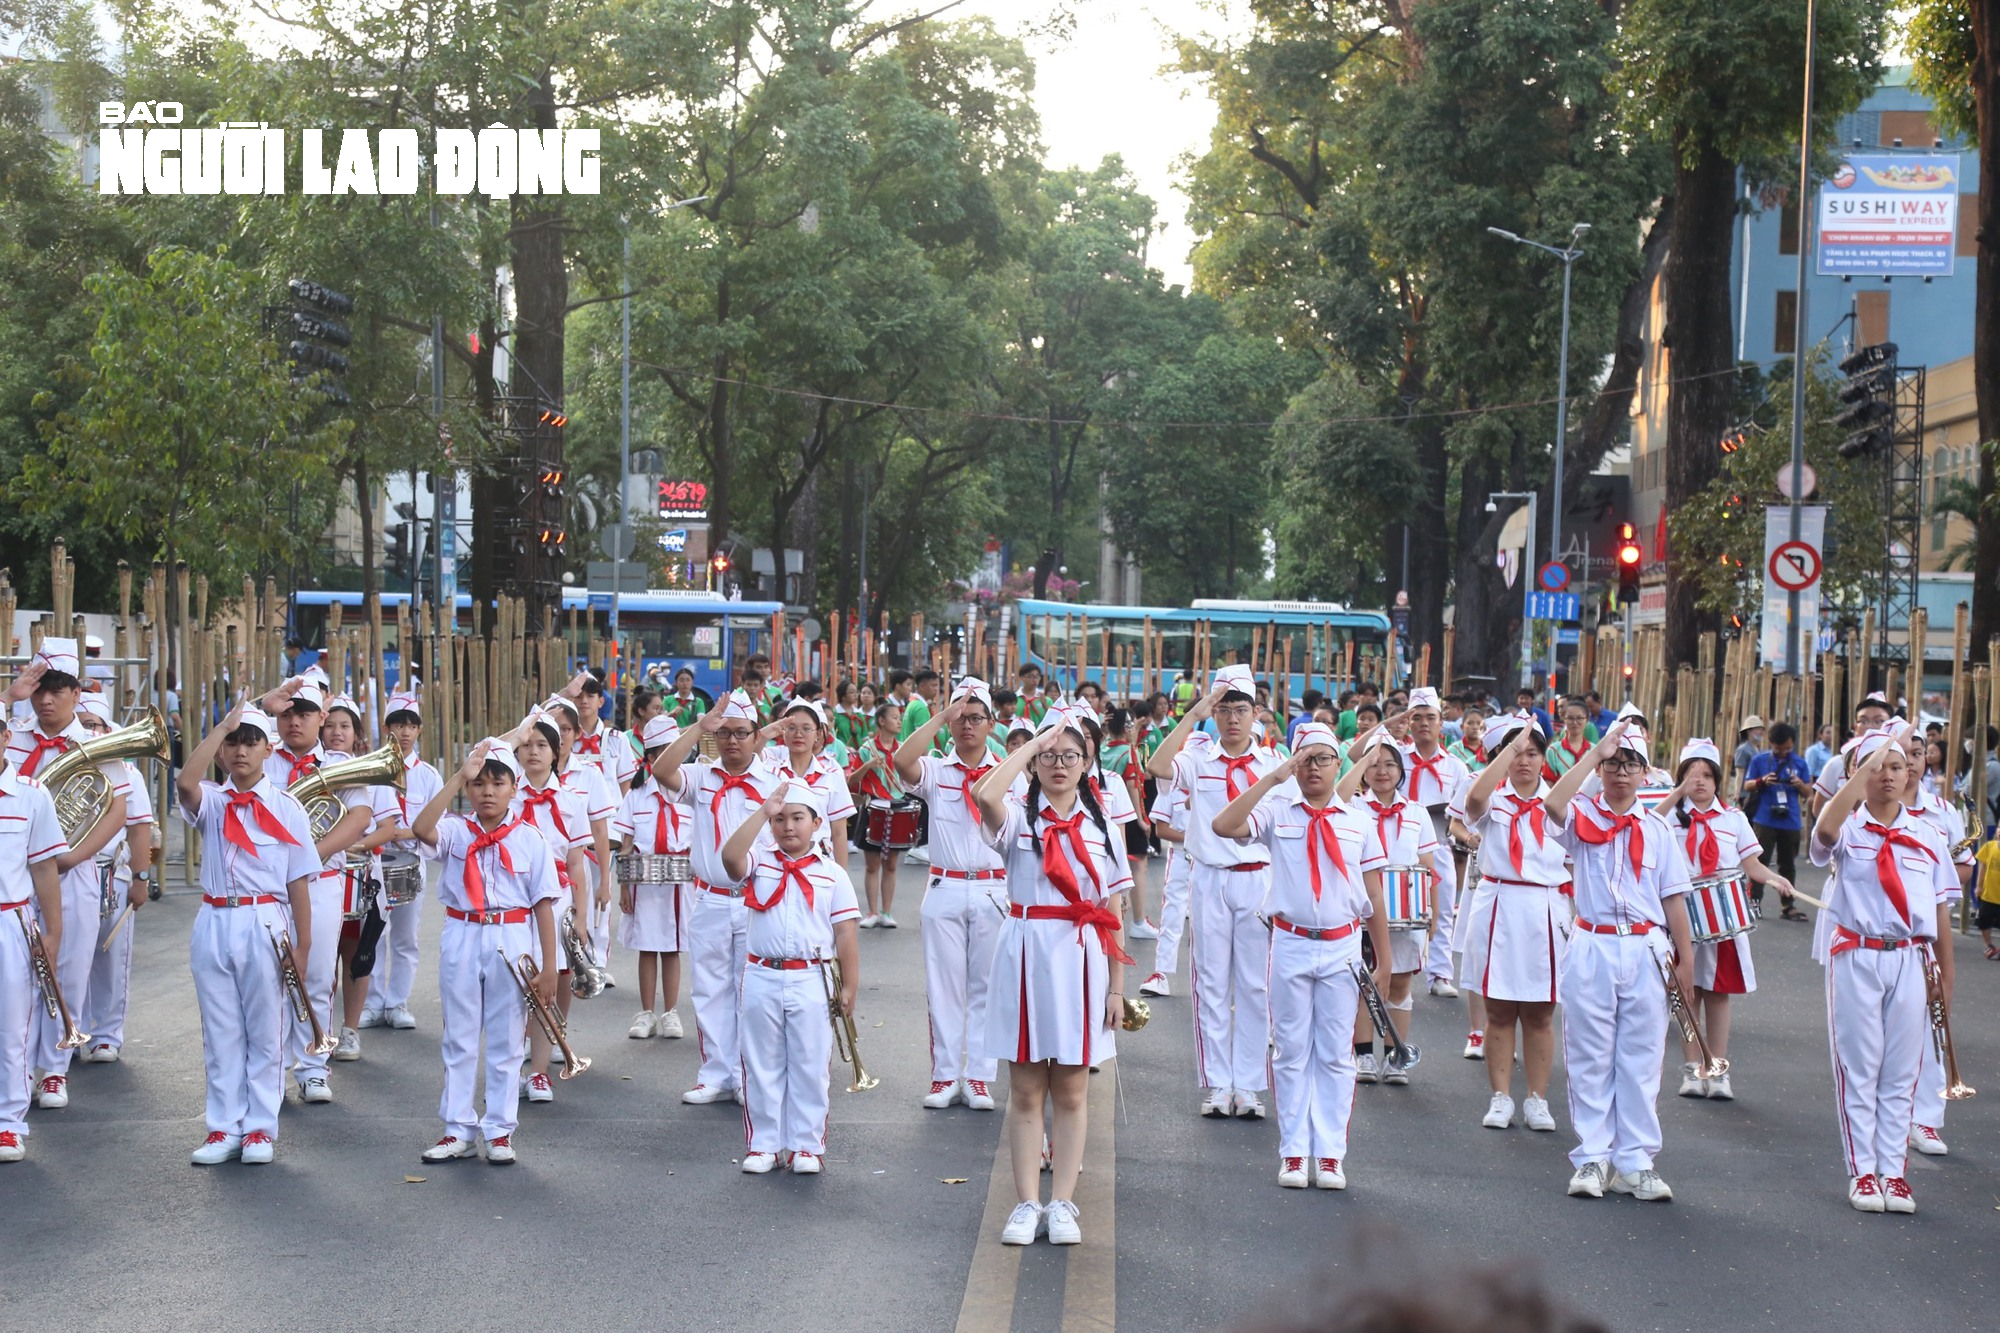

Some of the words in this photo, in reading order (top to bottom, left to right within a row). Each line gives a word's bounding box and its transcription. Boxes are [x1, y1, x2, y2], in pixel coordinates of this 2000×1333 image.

[1829, 200, 1896, 215] SUSHI
[1901, 200, 1948, 215] WAY
[1900, 217, 1946, 225] EXPRESS
[695, 628, 712, 643] 30
